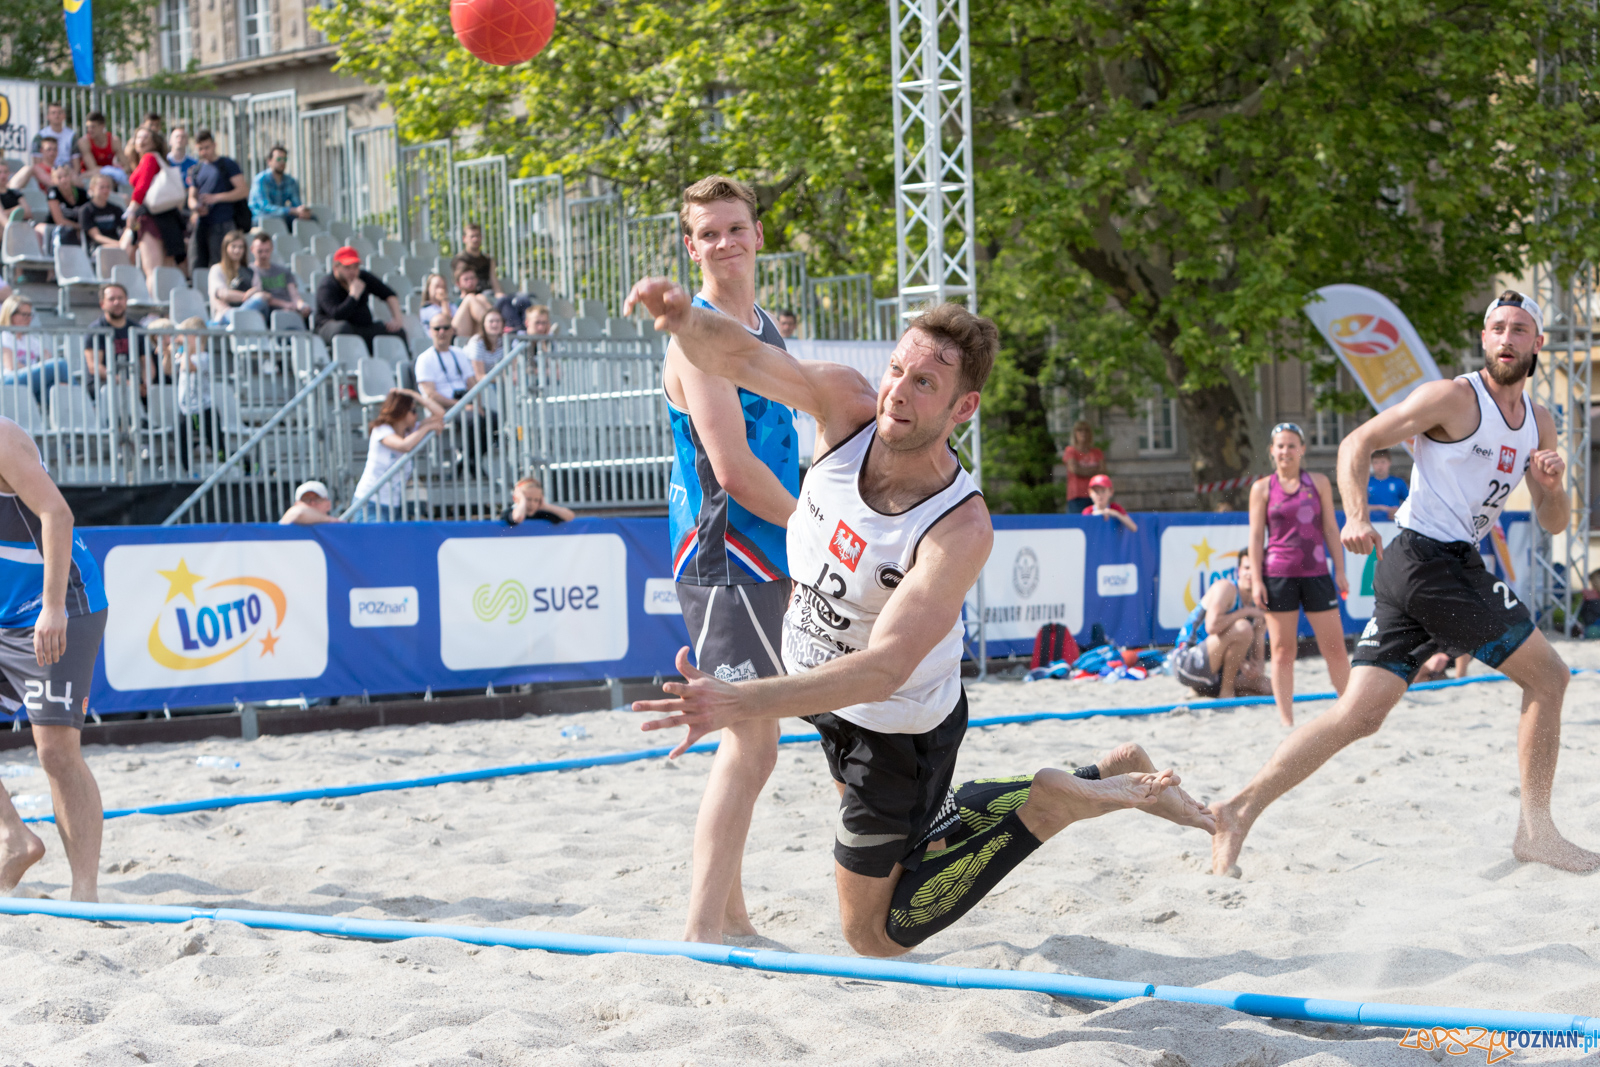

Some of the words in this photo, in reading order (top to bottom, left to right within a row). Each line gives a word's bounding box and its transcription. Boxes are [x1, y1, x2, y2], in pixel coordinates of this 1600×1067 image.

[1482, 479, 1511, 509] 22
[533, 585, 599, 612] suez
[1493, 581, 1518, 609] 2
[175, 593, 262, 650] LOTTO
[23, 679, 73, 711] 24
